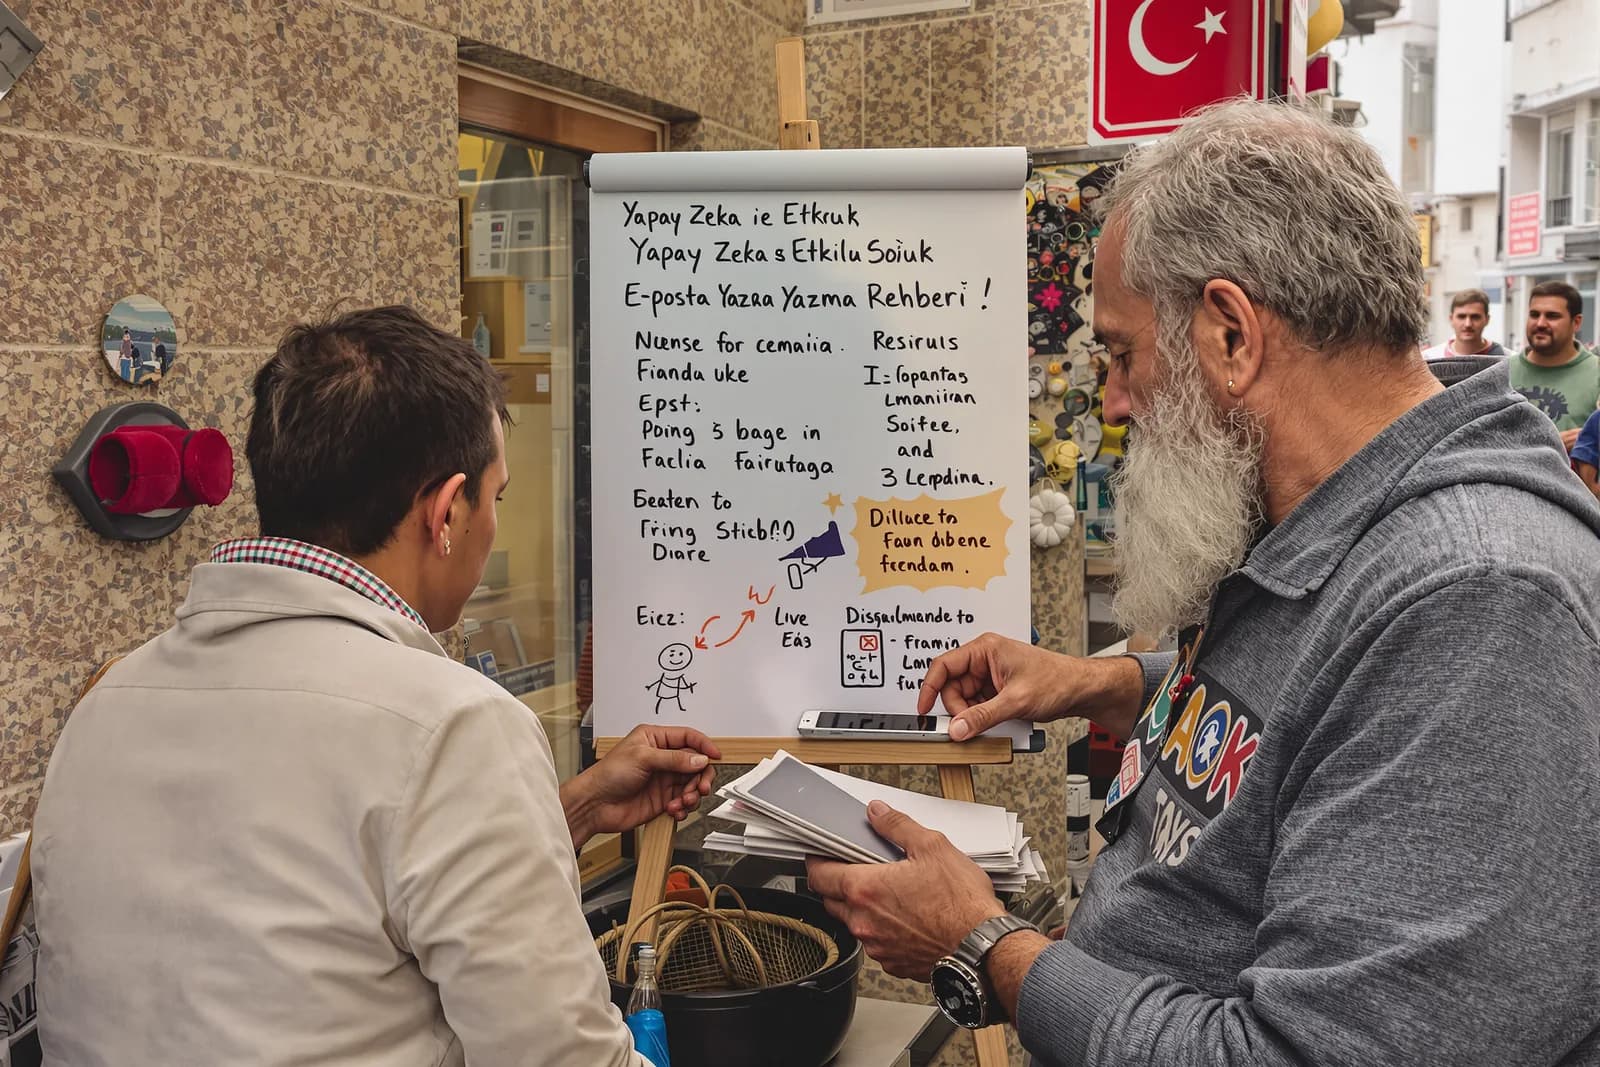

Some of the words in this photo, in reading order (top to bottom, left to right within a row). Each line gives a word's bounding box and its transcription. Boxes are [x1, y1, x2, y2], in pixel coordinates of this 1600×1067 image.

[622, 200, 682, 237] Yapay
[689, 204, 742, 227] Zeka
[629, 236, 702, 274] Yapay
[713, 239, 769, 264] Zeka
[624, 282, 711, 318] E-posta
[781, 285, 857, 313] Yazma
[716, 330, 745, 353] for
[736, 418, 788, 451] bage
[803, 424, 821, 441] in
[897, 438, 934, 458] and
[880, 467, 898, 488] 3
[711, 491, 732, 511] to
[956, 609, 974, 625] to
